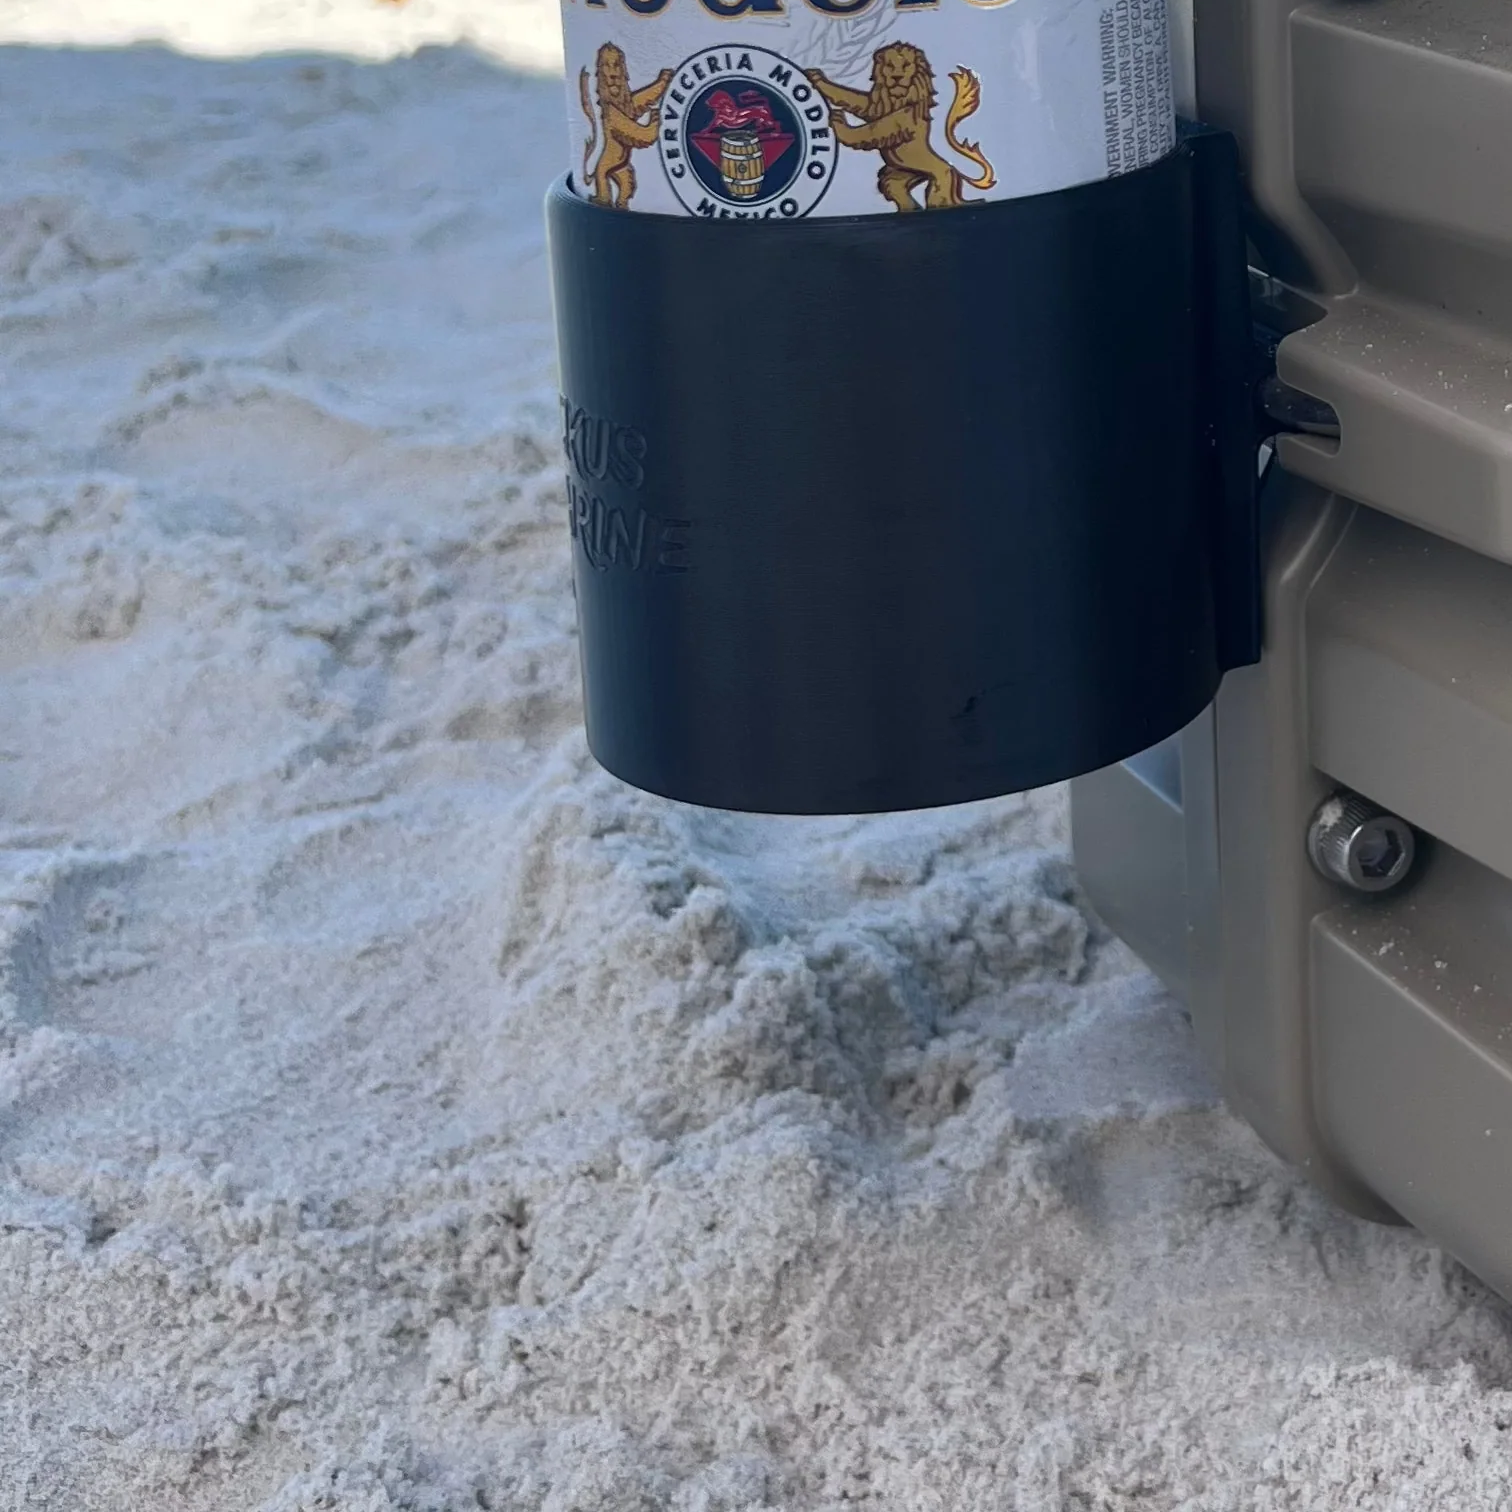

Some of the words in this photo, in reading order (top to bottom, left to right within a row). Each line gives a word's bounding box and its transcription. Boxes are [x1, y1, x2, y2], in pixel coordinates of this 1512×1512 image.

[1101, 8, 1117, 86] WARNING:
[1117, 0, 1129, 59] SHOULD
[664, 53, 754, 179] CERVECERIA
[768, 64, 831, 180] MODELO
[1120, 60, 1133, 118] WOMEN
[1124, 118, 1138, 172] NERAL,
